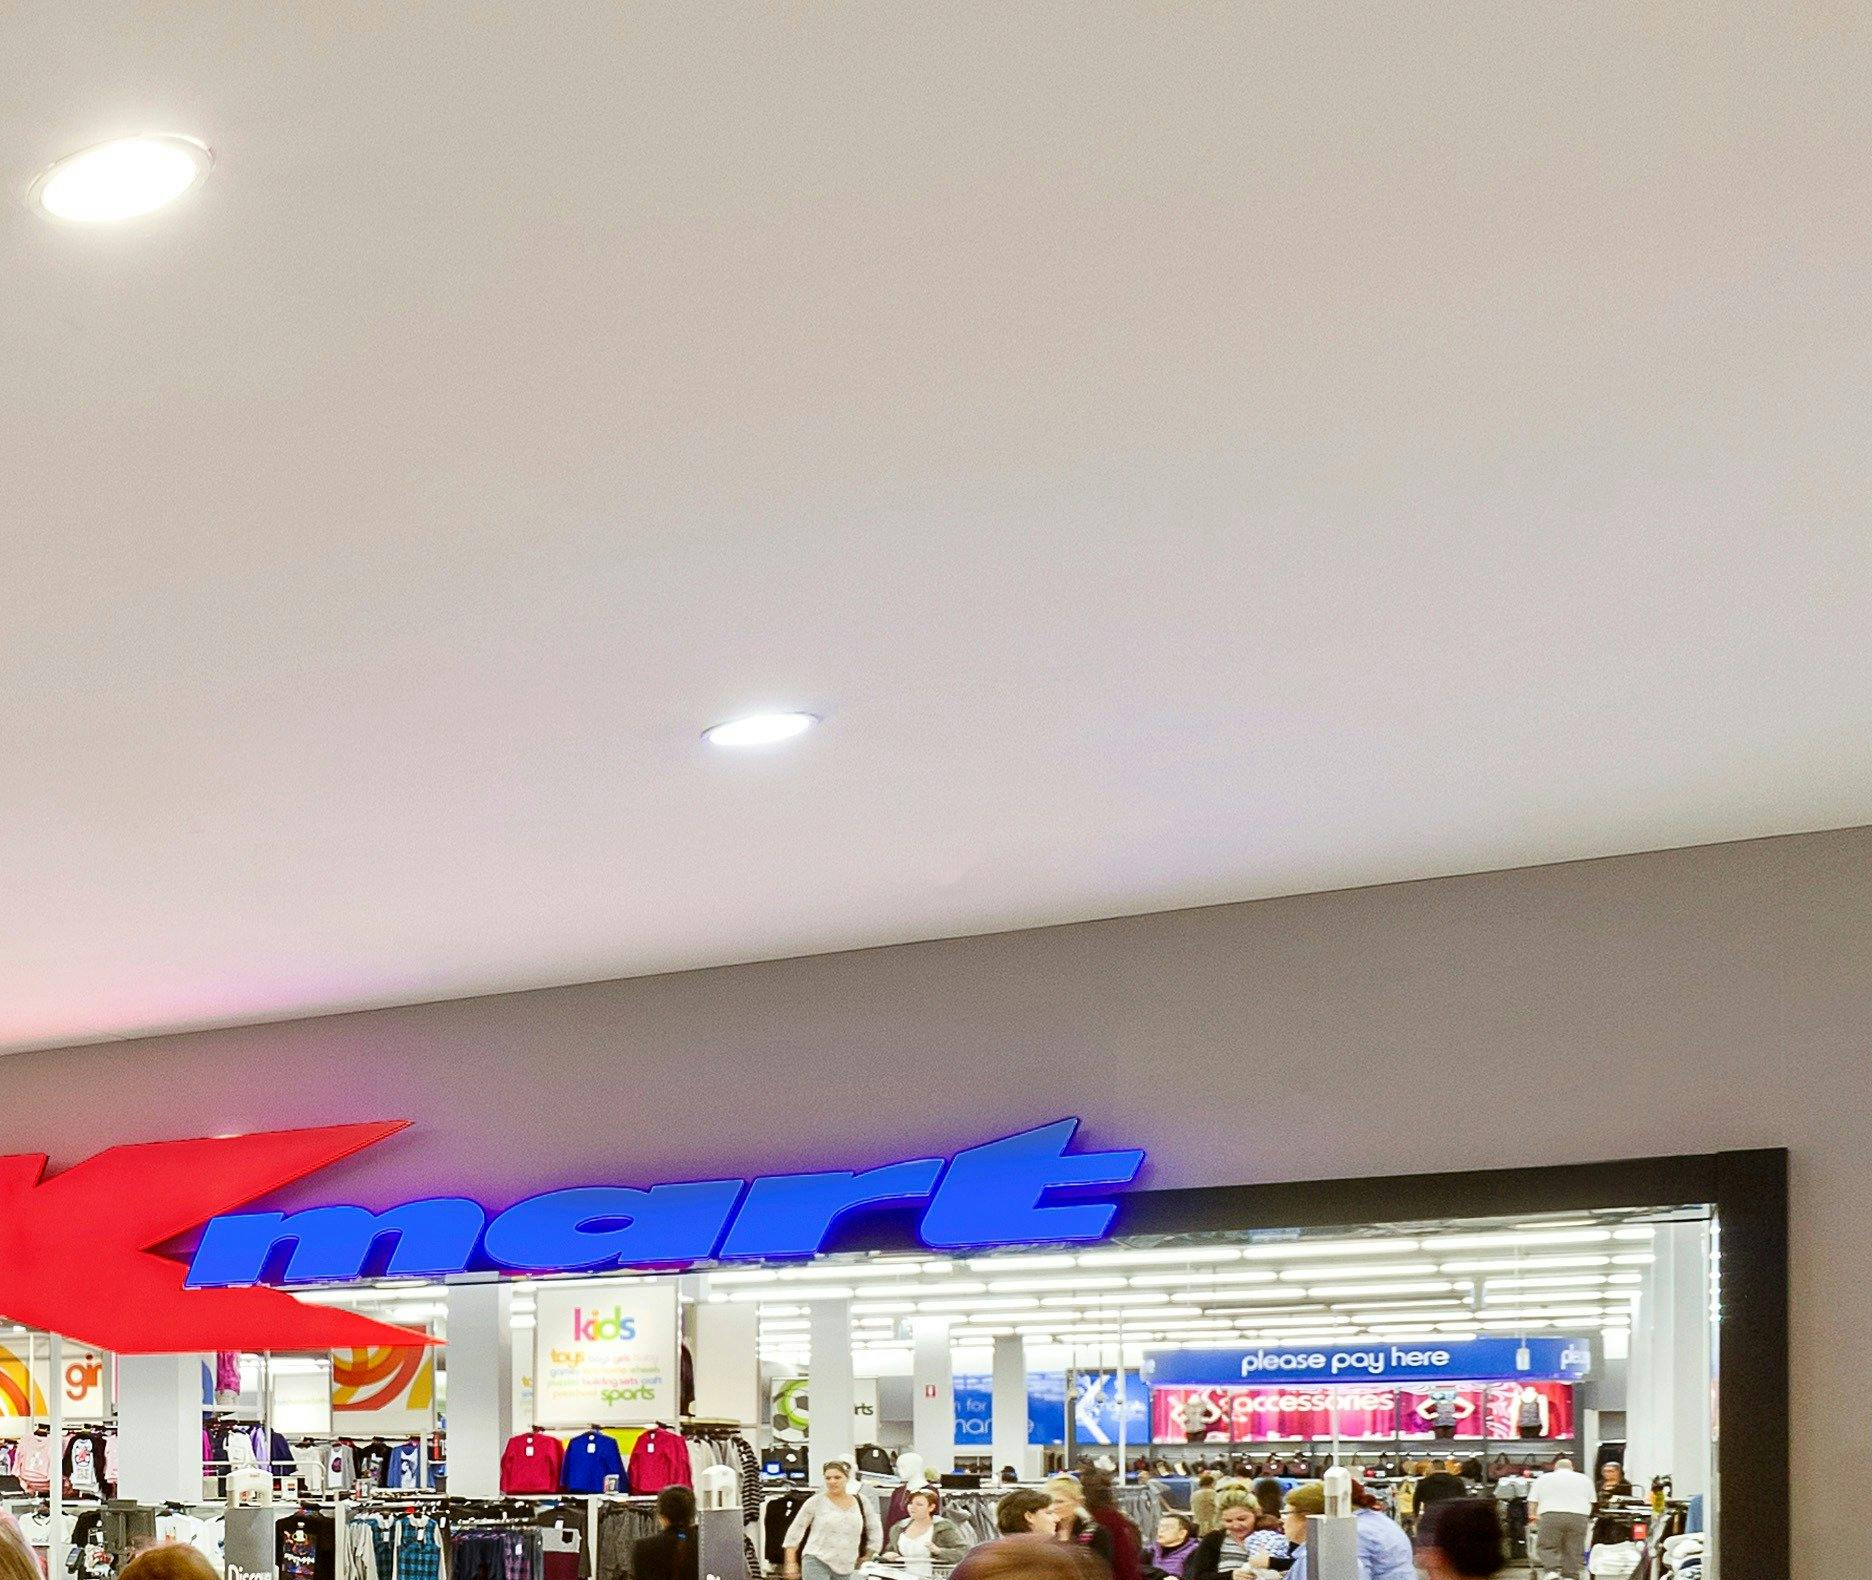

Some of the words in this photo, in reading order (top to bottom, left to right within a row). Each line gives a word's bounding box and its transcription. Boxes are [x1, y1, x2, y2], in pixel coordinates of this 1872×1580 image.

[574, 1305, 636, 1342] kids
[1241, 1348, 1326, 1377] please
[1331, 1349, 1386, 1374] pay
[1390, 1345, 1450, 1368] here
[601, 1385, 655, 1407] sports
[1233, 1392, 1396, 1413] accessories
[855, 1402, 874, 1416] rts
